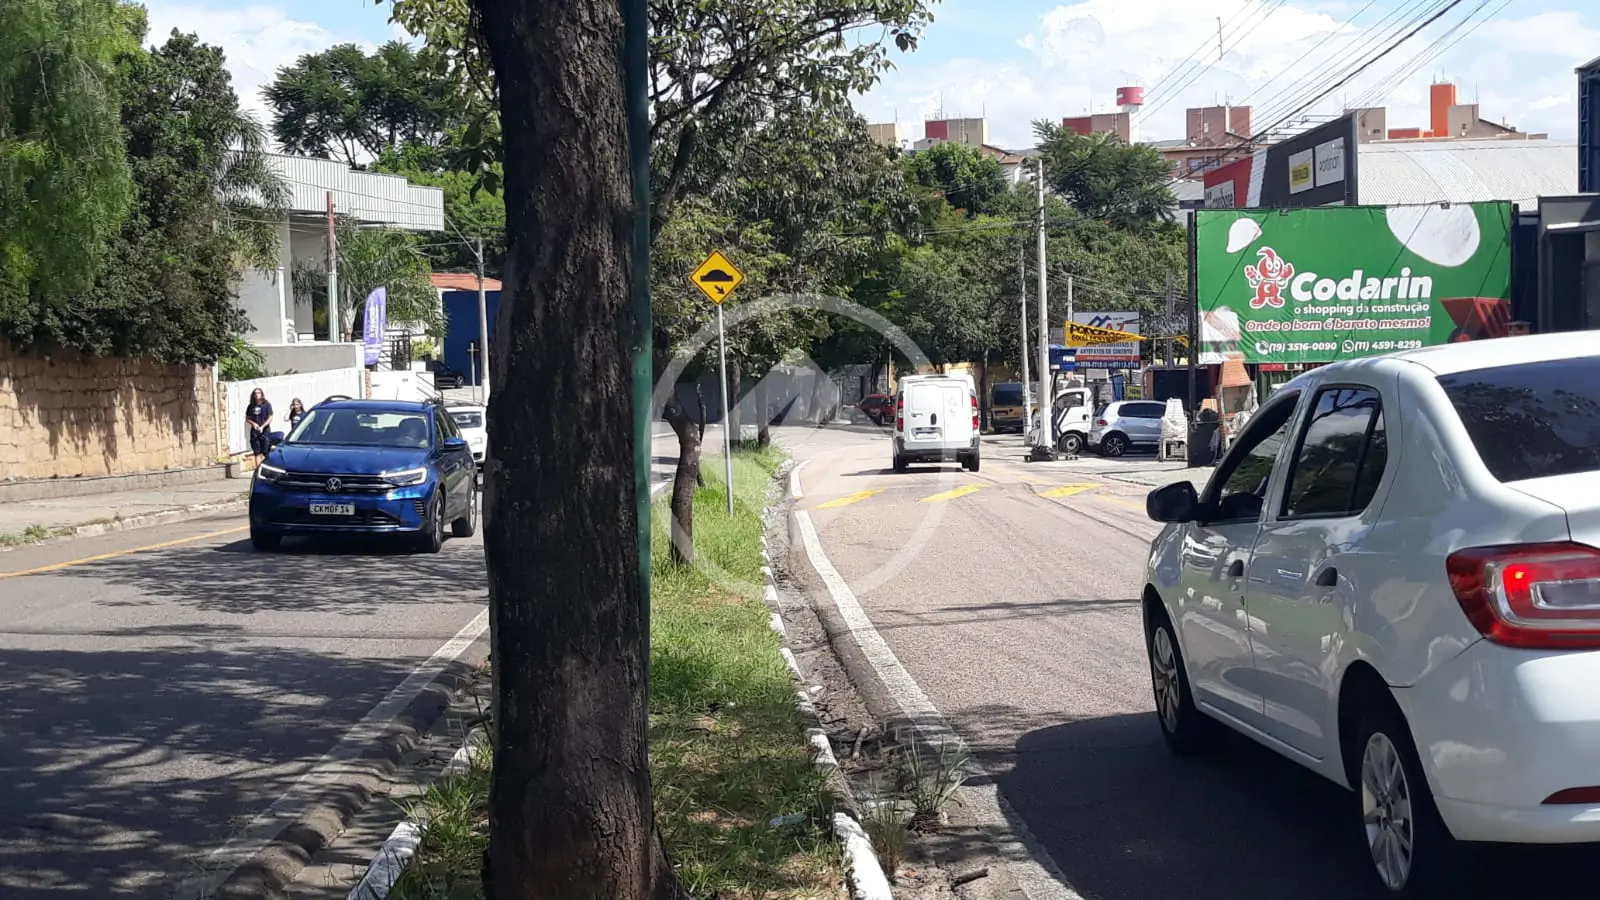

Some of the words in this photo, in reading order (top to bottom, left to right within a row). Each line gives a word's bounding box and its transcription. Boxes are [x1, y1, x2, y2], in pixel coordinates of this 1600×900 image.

[1291, 267, 1433, 302] Codarin
[1294, 307, 1301, 315] o
[1303, 303, 1354, 316] shopping
[1356, 303, 1370, 313] da
[1371, 303, 1430, 315] construção
[1246, 319, 1281, 332] Onde
[1282, 322, 1290, 331] o
[1292, 319, 1321, 332] bom
[1323, 317, 1334, 331] é
[1335, 318, 1377, 331] barato
[1379, 316, 1431, 330] mesmo!
[1287, 341, 1337, 351] 3516-0090
[1371, 340, 1422, 350] 4591-8299
